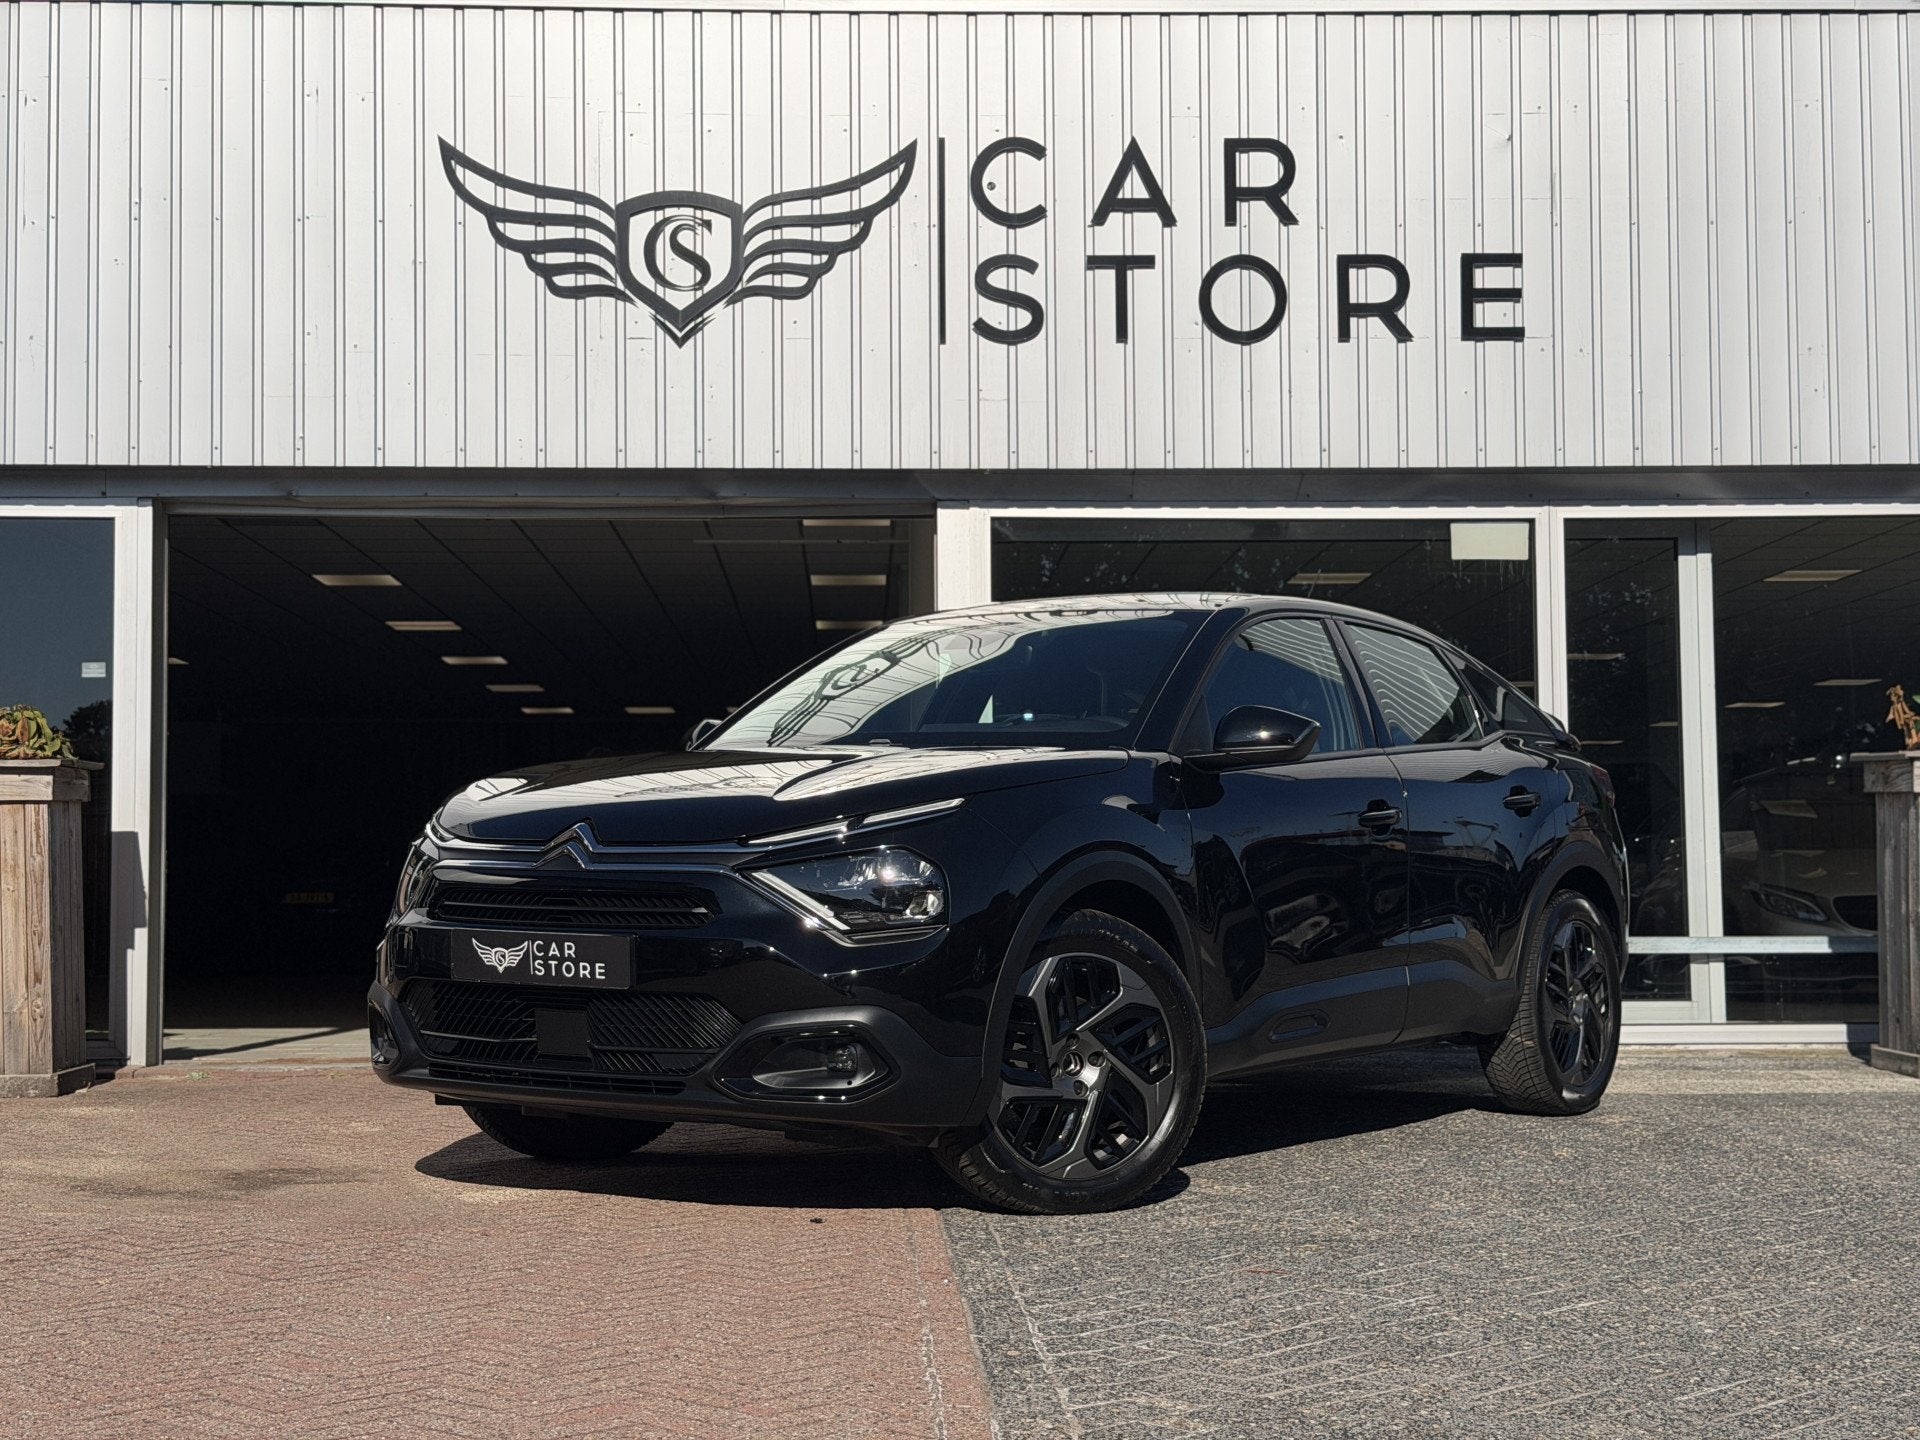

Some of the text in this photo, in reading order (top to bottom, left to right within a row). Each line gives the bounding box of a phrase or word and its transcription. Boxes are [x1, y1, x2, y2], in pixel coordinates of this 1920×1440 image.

[970, 136, 1299, 229] CAR
[973, 252, 1526, 346] STORE
[533, 940, 576, 958] CAR
[534, 959, 606, 980] STORE
